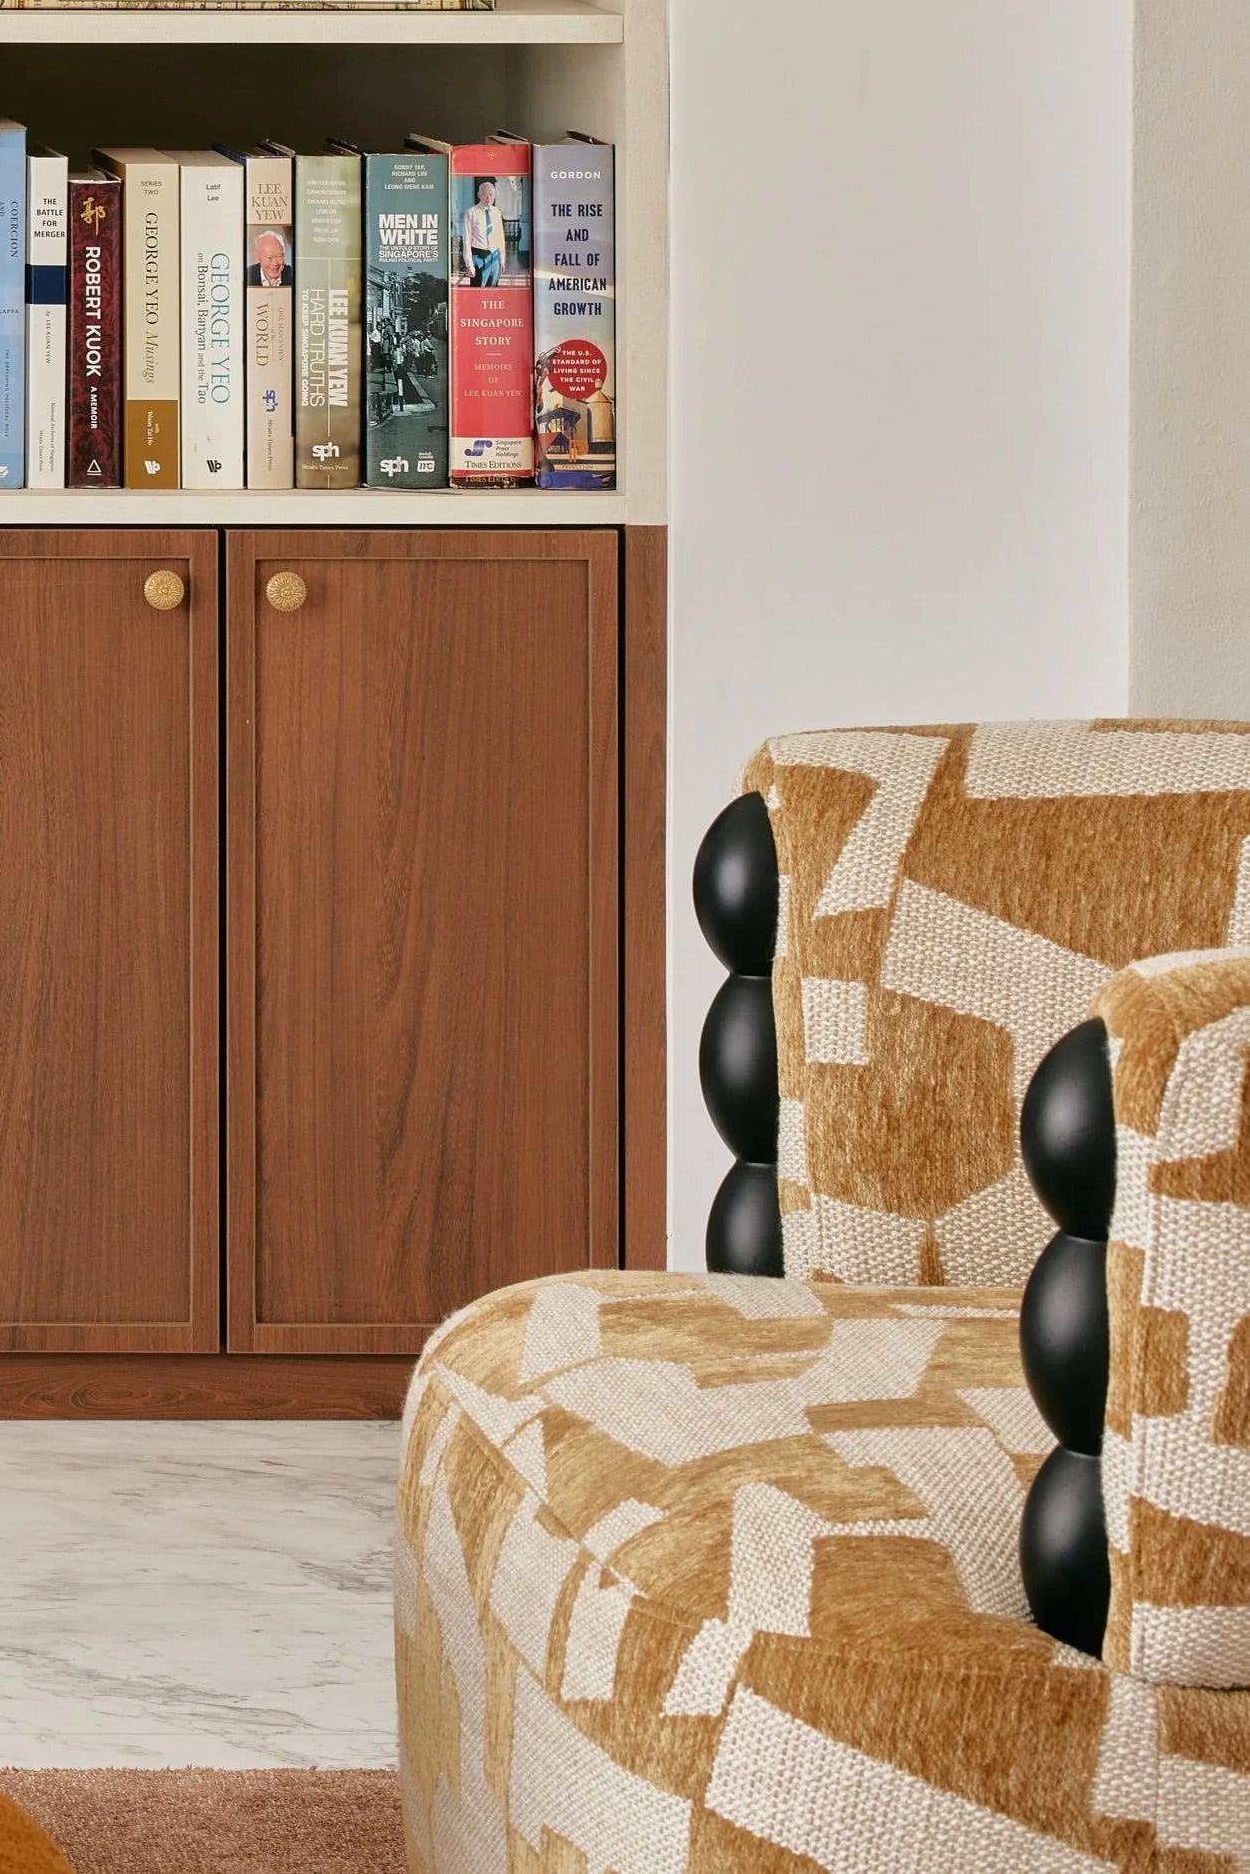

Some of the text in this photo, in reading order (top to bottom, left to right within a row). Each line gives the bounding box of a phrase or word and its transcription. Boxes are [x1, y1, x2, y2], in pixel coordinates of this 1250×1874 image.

[550, 171, 601, 179] GORDON
[258, 183, 282, 194] LEE
[251, 196, 288, 207] KUAN
[255, 209, 284, 220] YEW
[551, 204, 603, 217] THE RISE
[379, 214, 438, 229] MEN IN
[10, 200, 19, 258] COERCION
[565, 229, 589, 241] AND
[379, 229, 438, 245] WHITE
[379, 250, 439, 258] SINGAPORE'S
[554, 253, 601, 266] FALL OF
[85, 246, 101, 319] ROBERT
[548, 278, 607, 291] AMERICAN
[142, 212, 159, 385] GEORGE YEO Musings
[481, 300, 505, 310] THE
[553, 302, 602, 316] GROWTH
[211, 253, 231, 404] GEORGE YEO
[460, 318, 524, 327] SINGAPORE
[255, 302, 269, 367] WORLD
[301, 289, 310, 407] TO KEEP SINGAPORE GOING
[309, 289, 326, 407] HARD TRUTHS
[328, 289, 349, 407] LEE KUAN YEW
[475, 337, 512, 346] STORY
[85, 325, 101, 377] KUOK
[474, 363, 513, 371] MEMOIRS
[464, 389, 522, 397] LEE KUAN YEW
[90, 394, 98, 430] MEMOIR
[380, 456, 409, 477] sph
